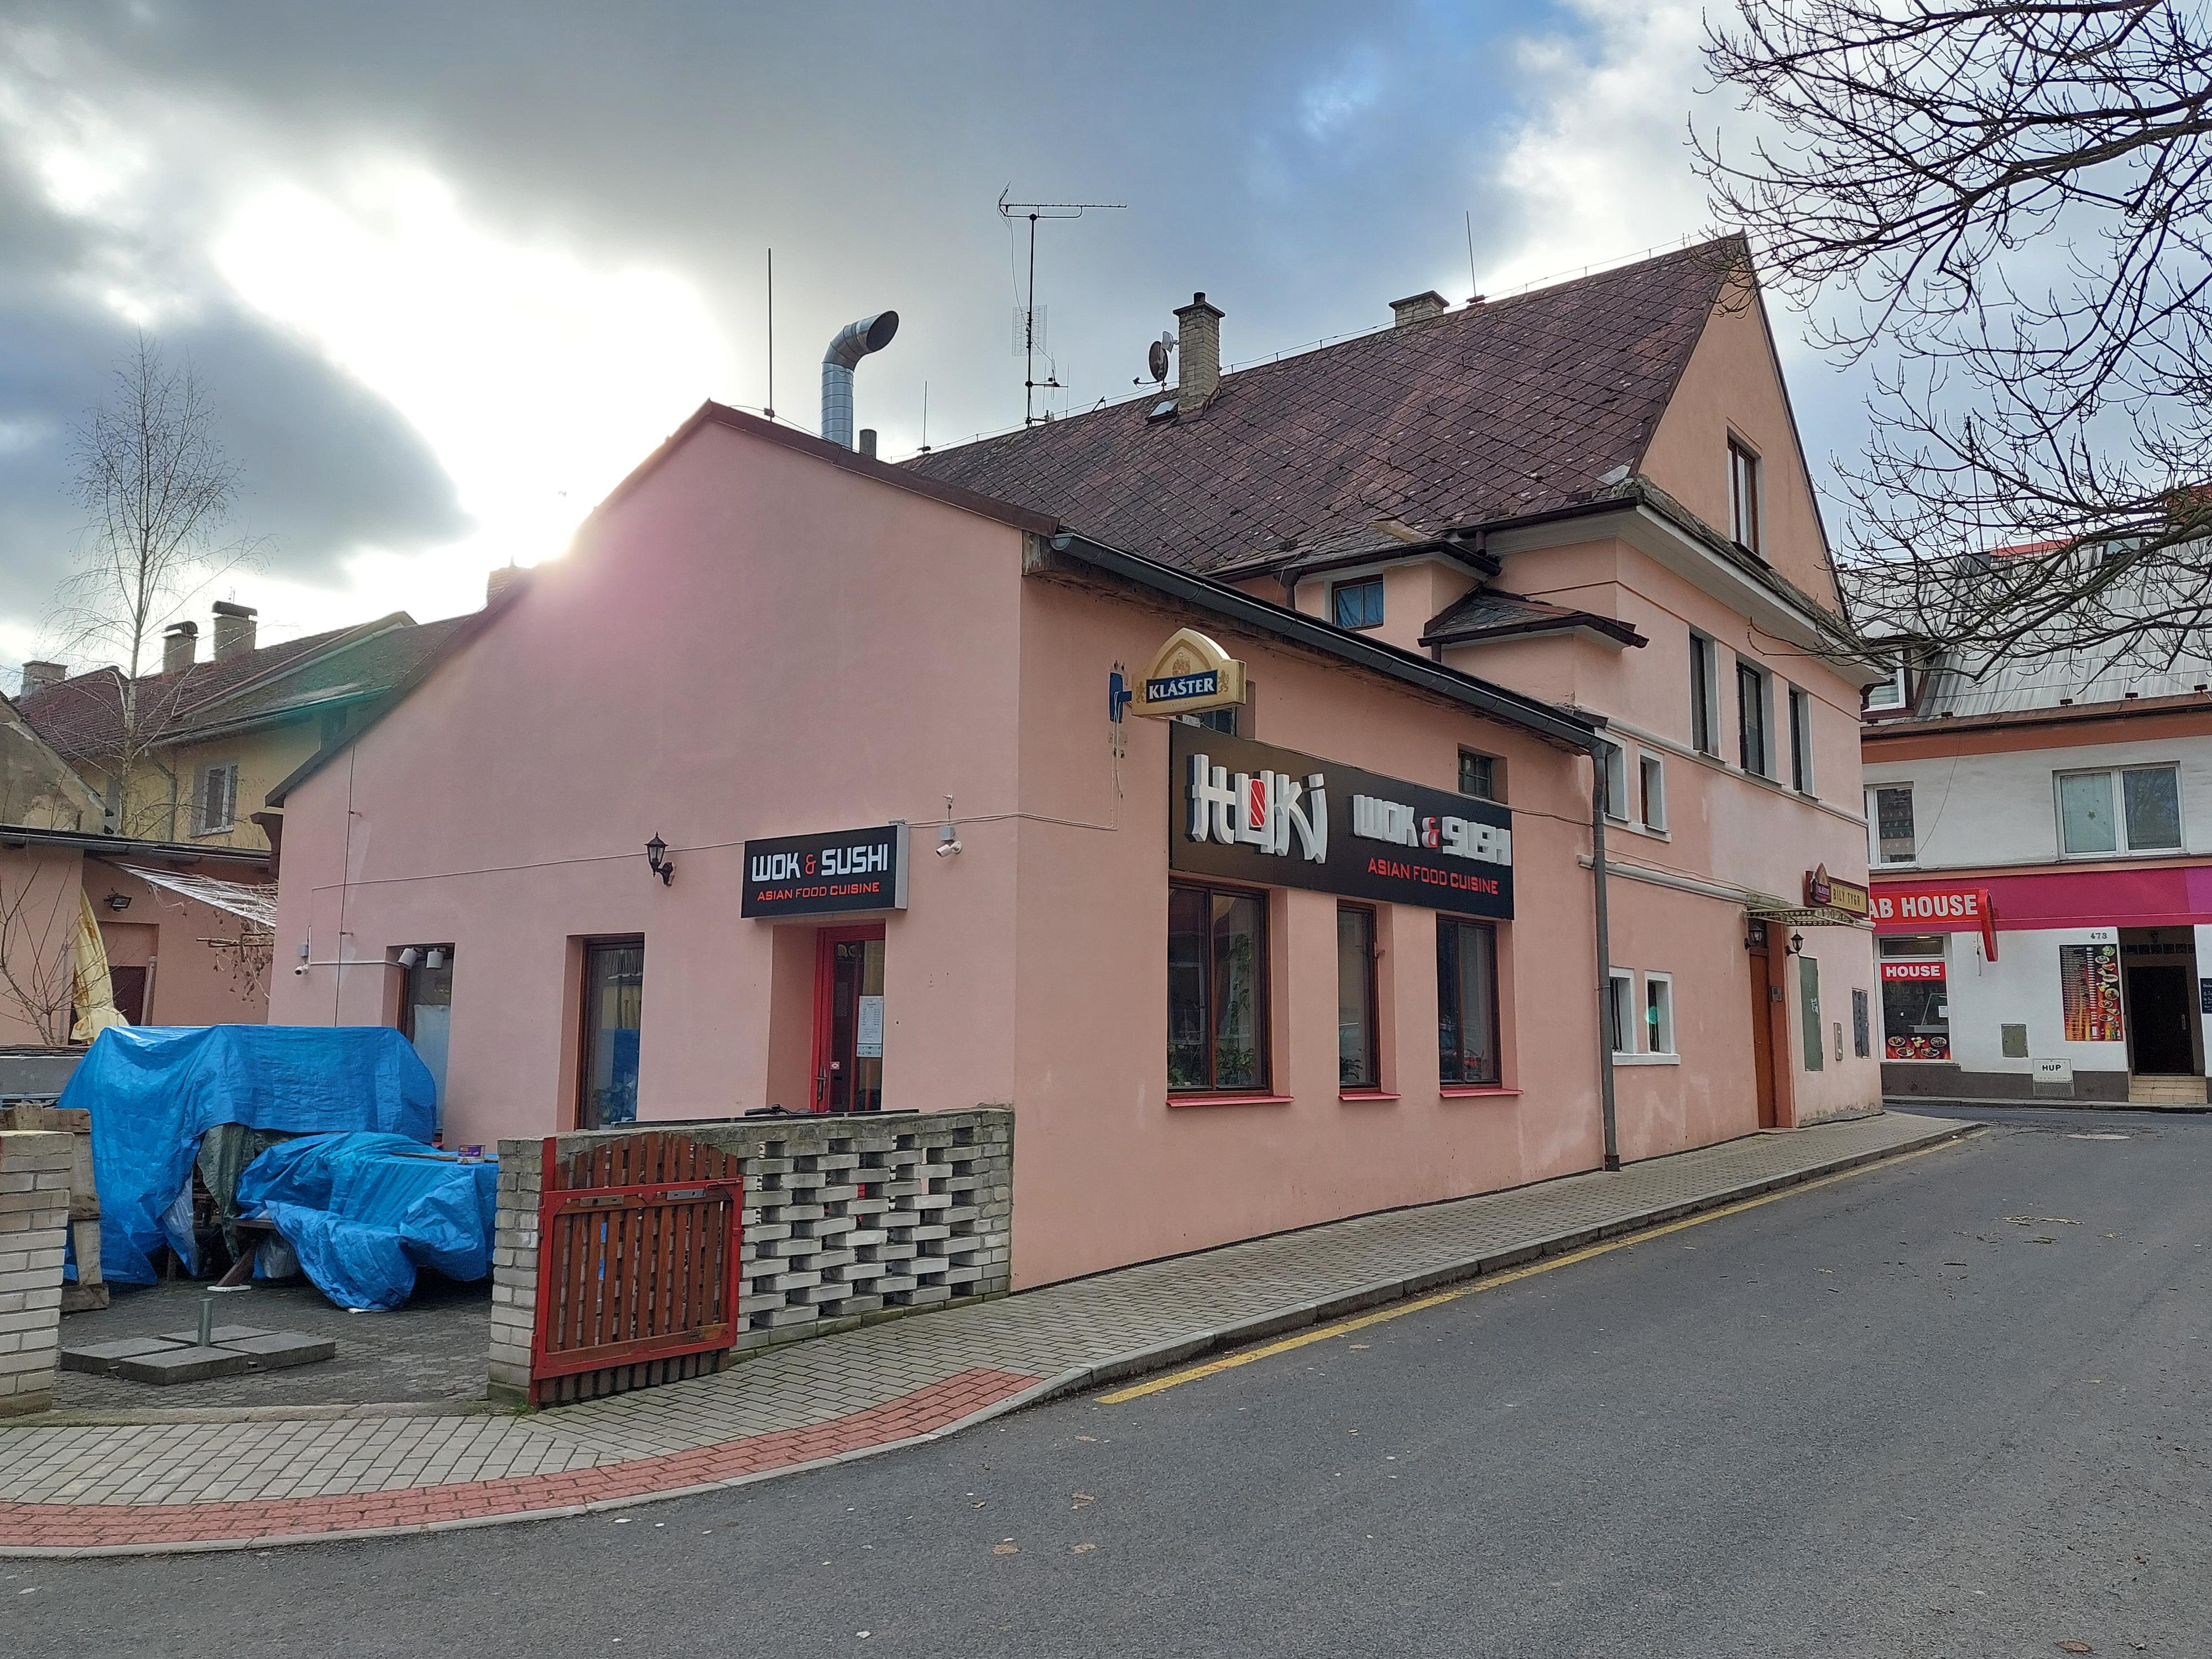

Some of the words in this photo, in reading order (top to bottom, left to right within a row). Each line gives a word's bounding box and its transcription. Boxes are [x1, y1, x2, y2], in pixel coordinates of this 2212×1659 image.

[1149, 677, 1215, 700] KLÁŠTER
[1353, 794, 1419, 847] WOK
[1422, 816, 1439, 848] &
[1442, 816, 1512, 867] SUSHI
[752, 852, 801, 882] WOK
[805, 854, 816, 874] &
[821, 843, 888, 876] SUSHI
[1368, 858, 1411, 880] ASIAN
[1413, 865, 1448, 886] FOOD
[1450, 873, 1499, 895] CUISINE
[757, 889, 793, 901] ASIAN
[795, 886, 827, 898] FOOD
[830, 881, 880, 896] CUISINE
[1847, 892, 1860, 906] TYGR
[1901, 894, 1978, 918] HOUSE
[1886, 965, 1940, 977] HOUSE
